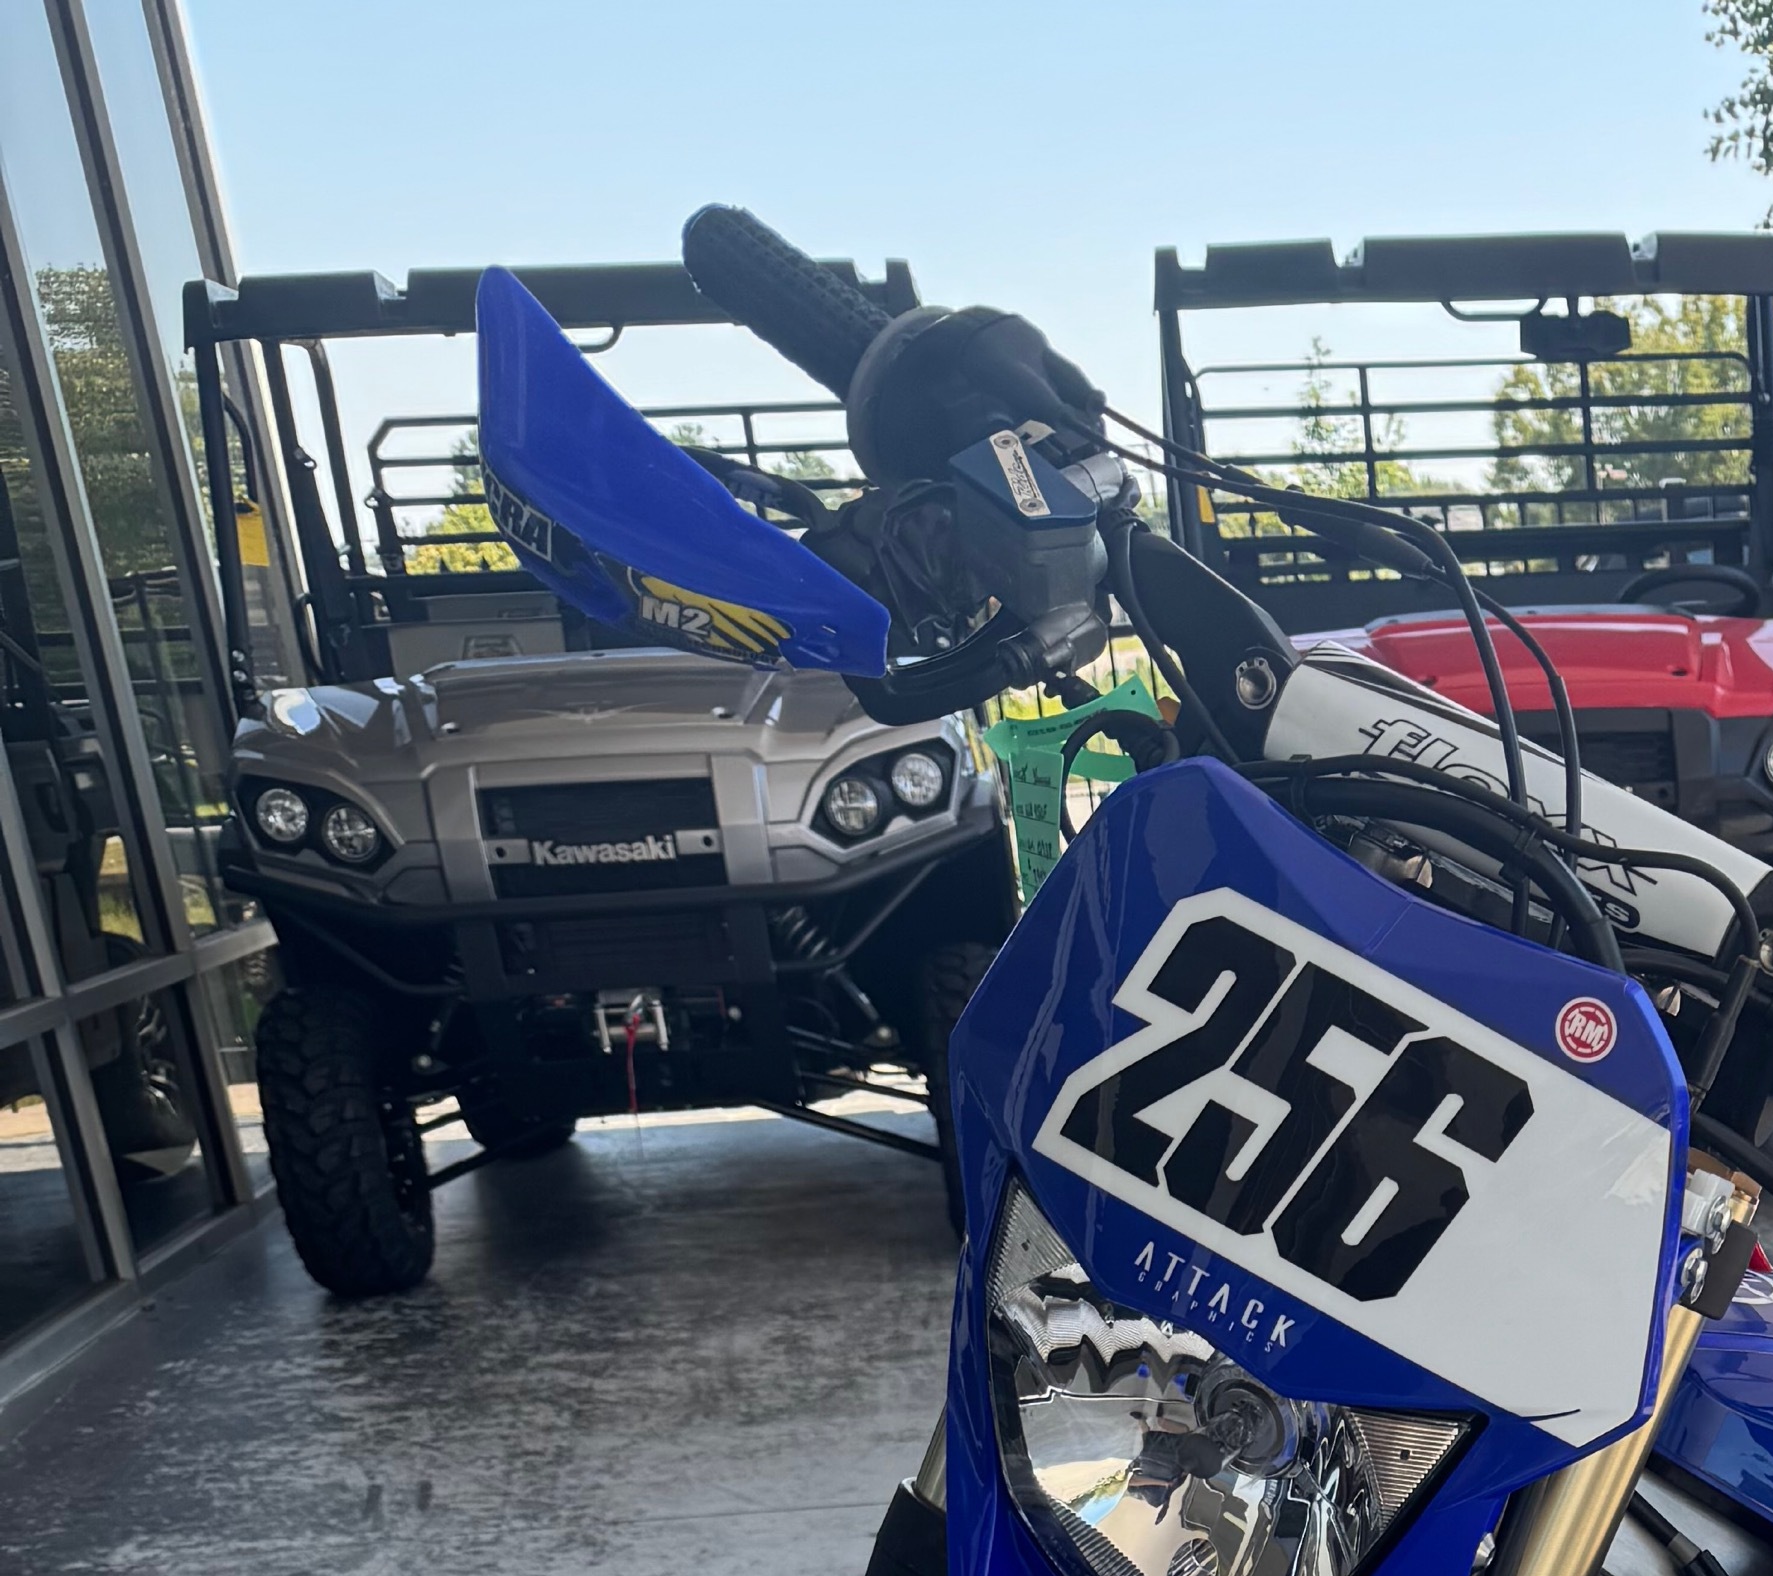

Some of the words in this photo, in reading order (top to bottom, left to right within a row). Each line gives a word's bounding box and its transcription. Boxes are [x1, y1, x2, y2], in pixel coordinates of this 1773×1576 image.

[641, 596, 711, 637] M2
[531, 834, 676, 866] Kawasaki
[1060, 915, 1535, 1302] 256
[1134, 1241, 1296, 1348] ATTACK
[1137, 1271, 1273, 1353] GRAPHICS
